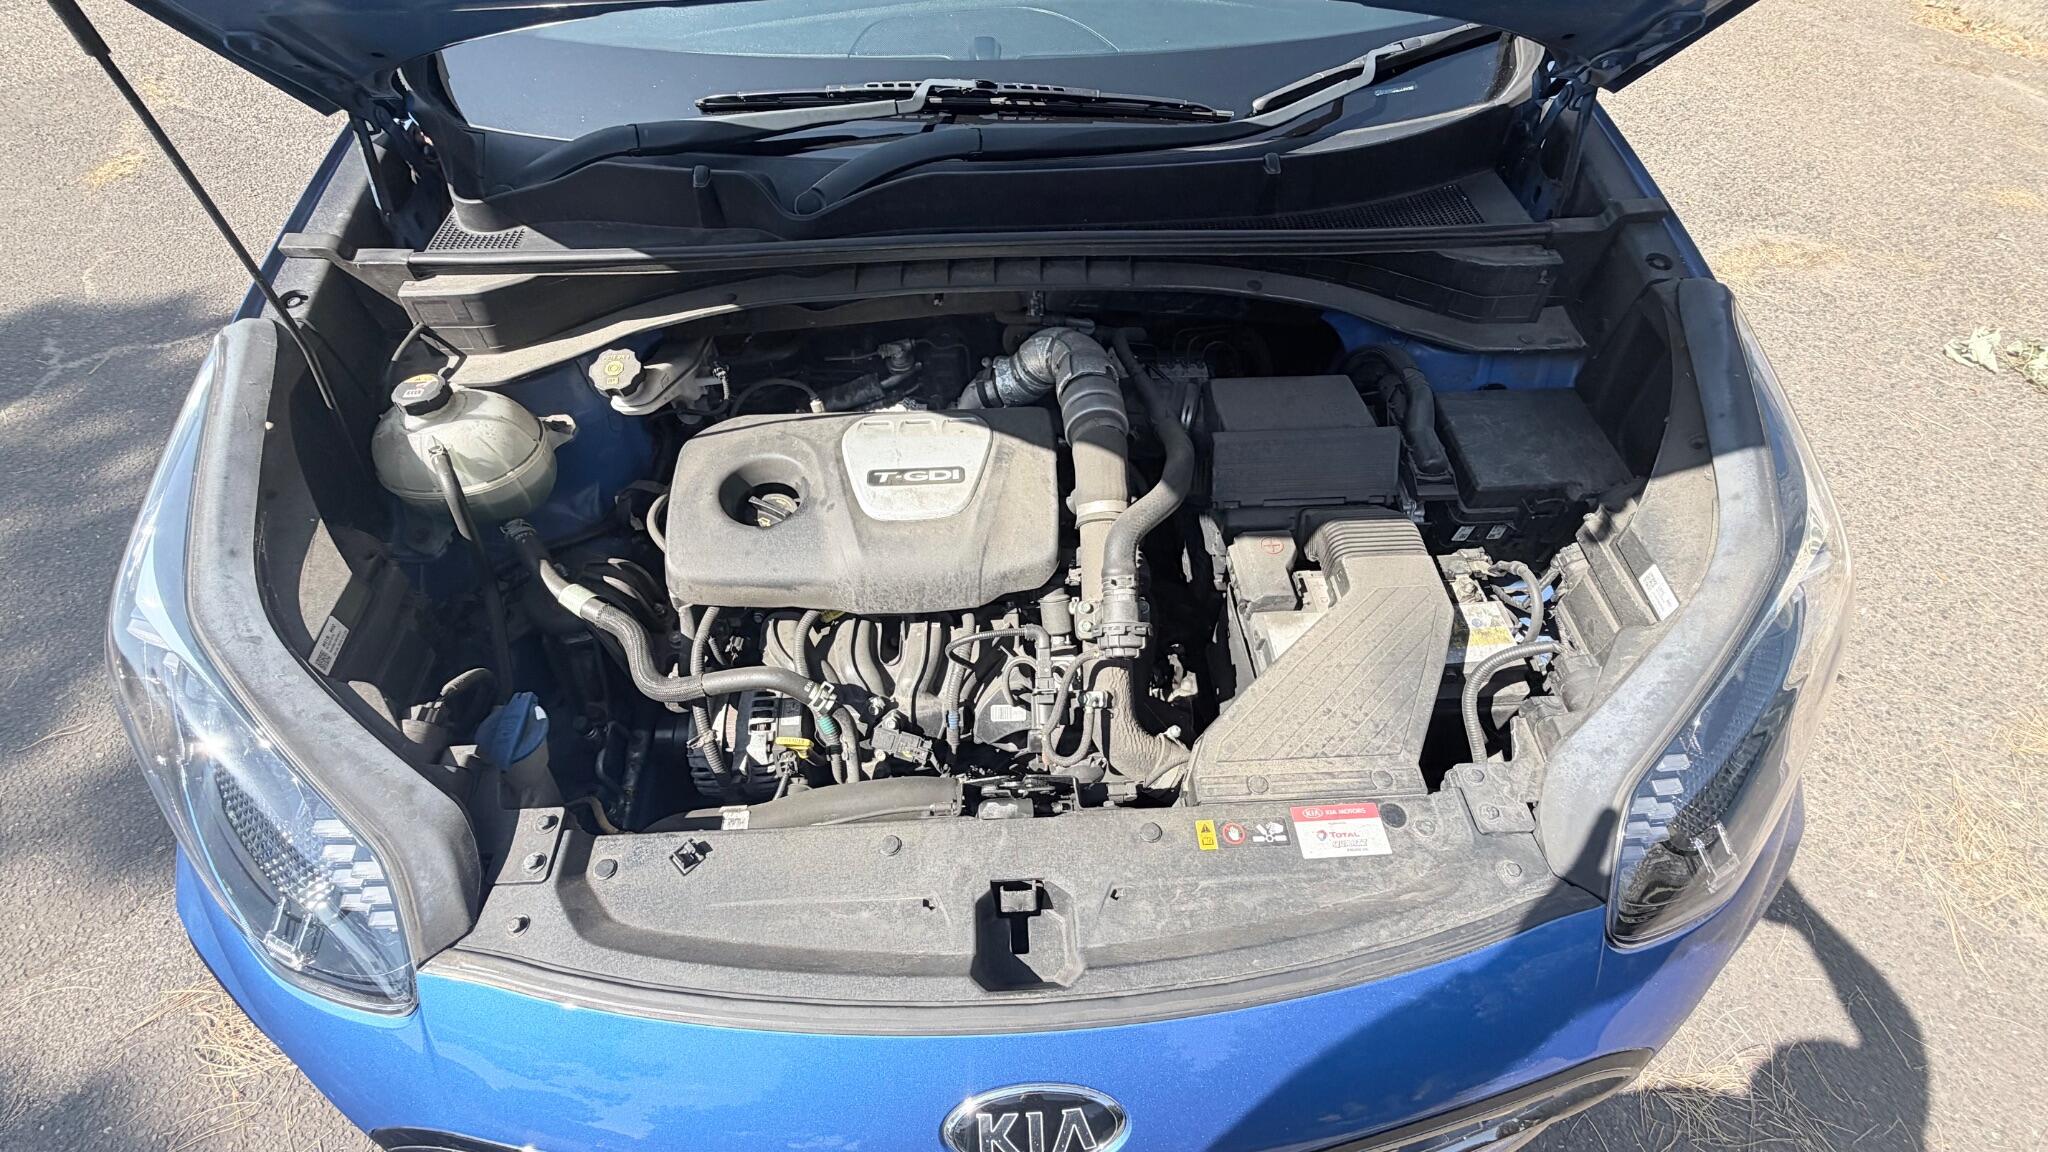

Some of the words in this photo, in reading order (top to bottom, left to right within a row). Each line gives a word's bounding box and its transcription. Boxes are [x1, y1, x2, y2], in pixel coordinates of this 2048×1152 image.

[874, 469, 959, 483] T-GDI
[1305, 808, 1321, 817] KIA
[1338, 807, 1366, 815] MOTORS
[1329, 831, 1360, 839] TOTAL
[976, 1107, 1097, 1152] KIA
